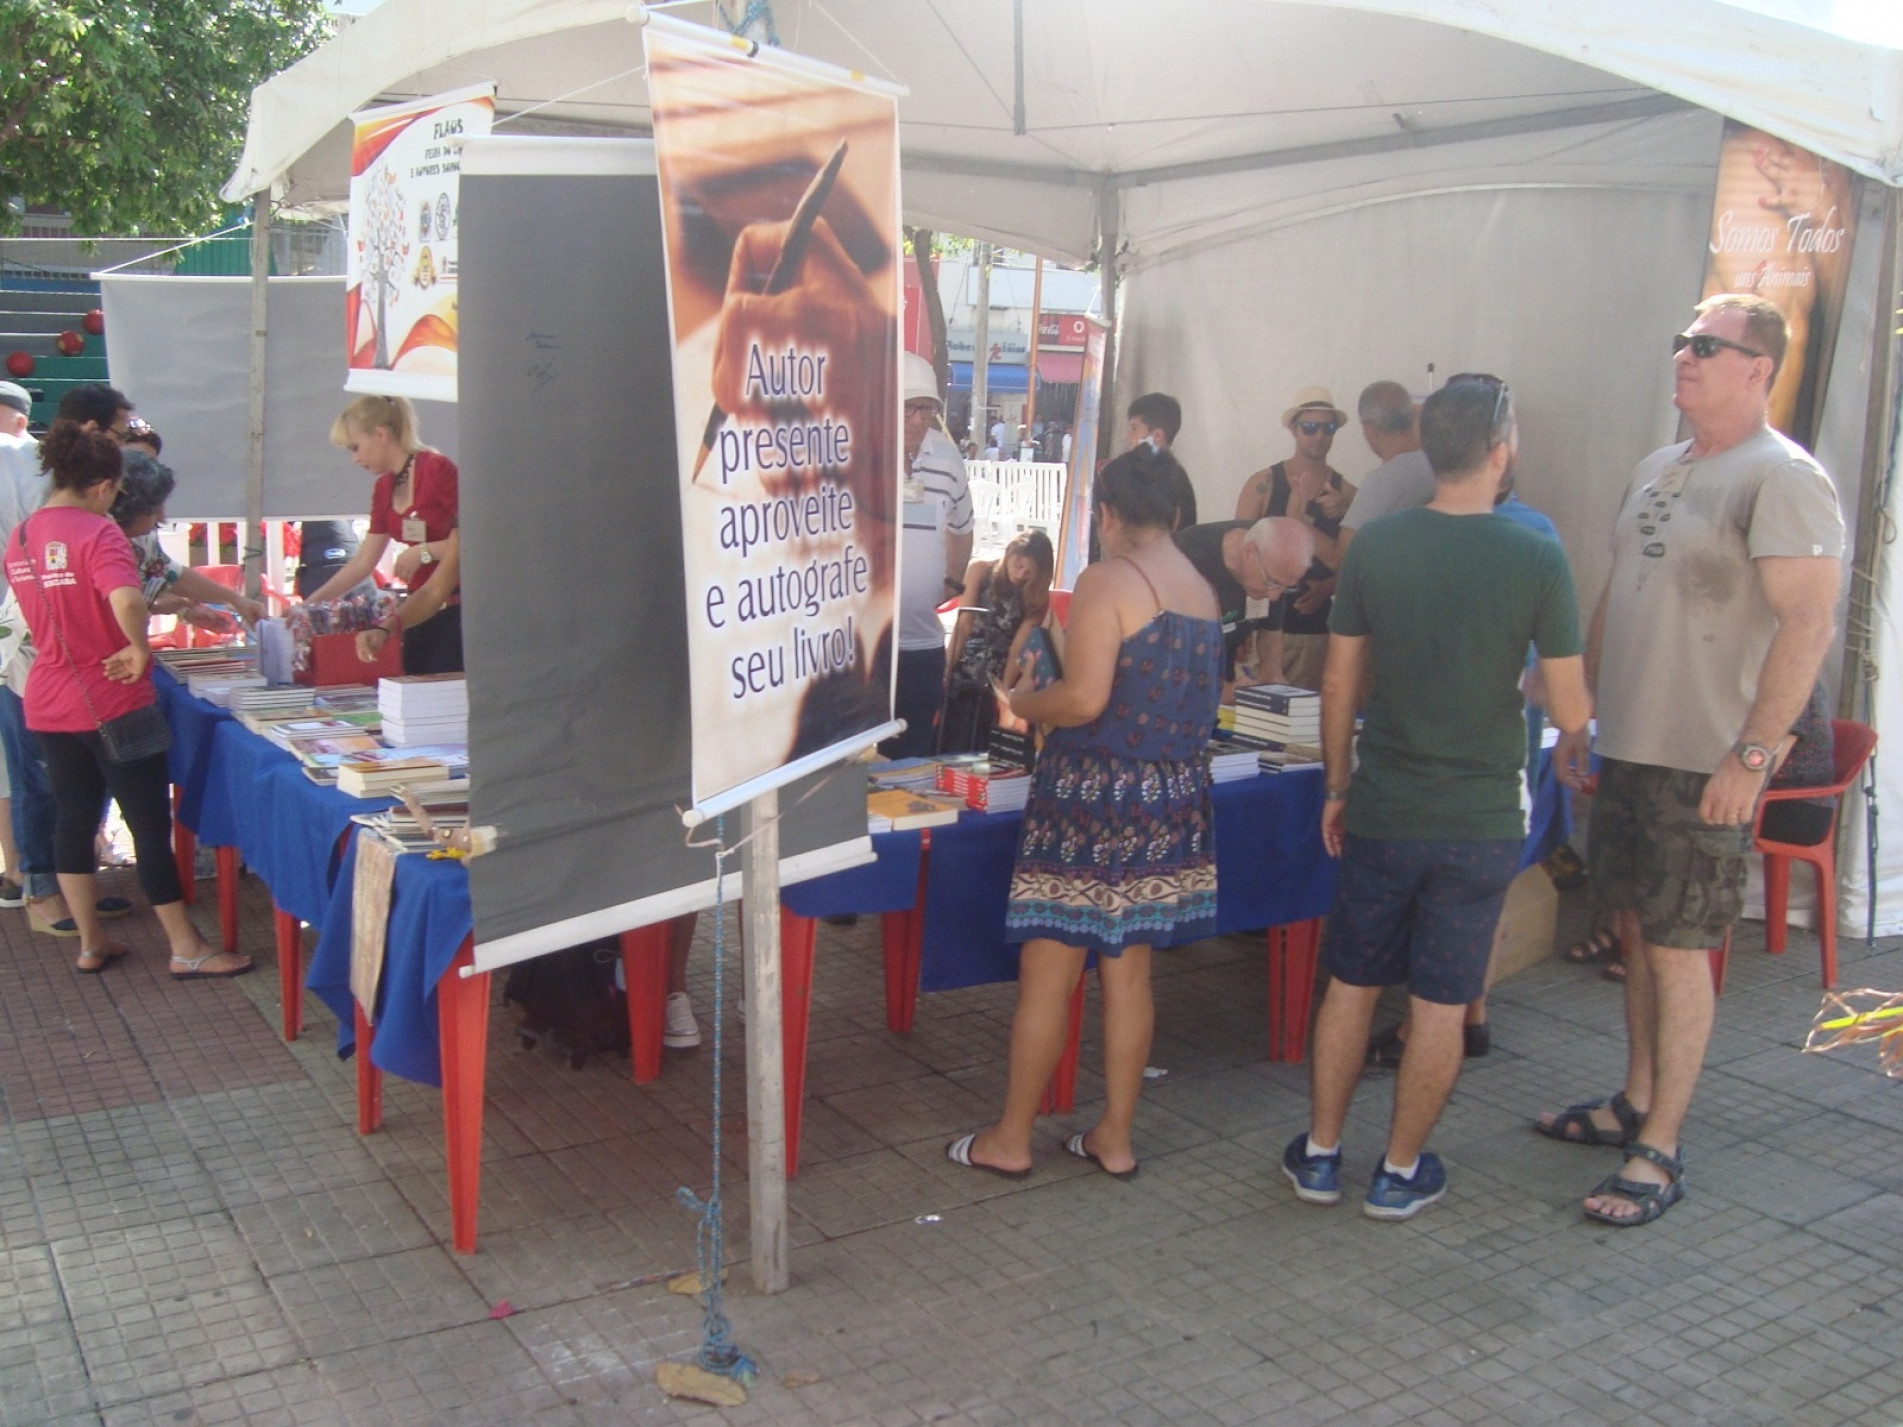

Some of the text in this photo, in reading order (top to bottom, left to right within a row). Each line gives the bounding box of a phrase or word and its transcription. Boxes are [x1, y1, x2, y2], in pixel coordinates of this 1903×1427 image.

[1709, 205, 1845, 254] Somos Todos
[745, 343, 827, 396] Autor
[719, 418, 850, 484] presente
[720, 487, 854, 558] aproveite
[706, 545, 868, 628] e autografe
[731, 615, 855, 699] seu livro!
